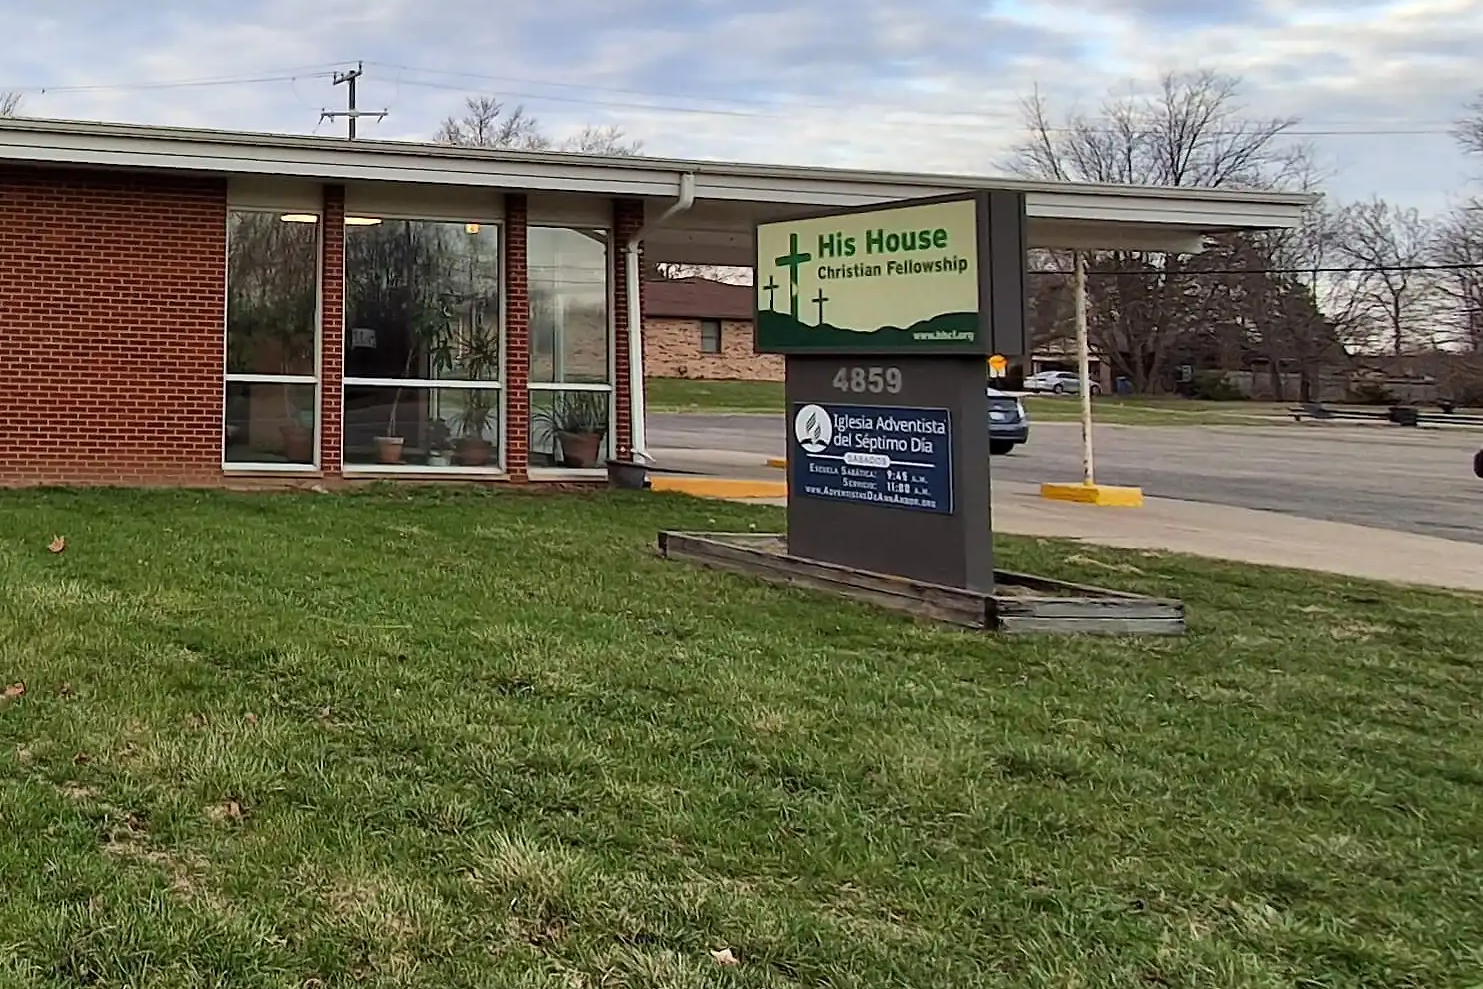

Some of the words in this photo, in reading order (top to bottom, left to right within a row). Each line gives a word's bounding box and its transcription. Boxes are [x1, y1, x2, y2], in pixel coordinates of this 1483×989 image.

[817, 232, 856, 258] His
[866, 227, 948, 254] House
[817, 262, 881, 280] Christian
[887, 256, 968, 277] Fellowship
[832, 367, 903, 393] 4859
[833, 413, 873, 432] Iglesia
[876, 416, 946, 435] Adventista
[833, 432, 852, 447] del
[855, 433, 908, 452] Séptimo
[911, 438, 934, 453] Día
